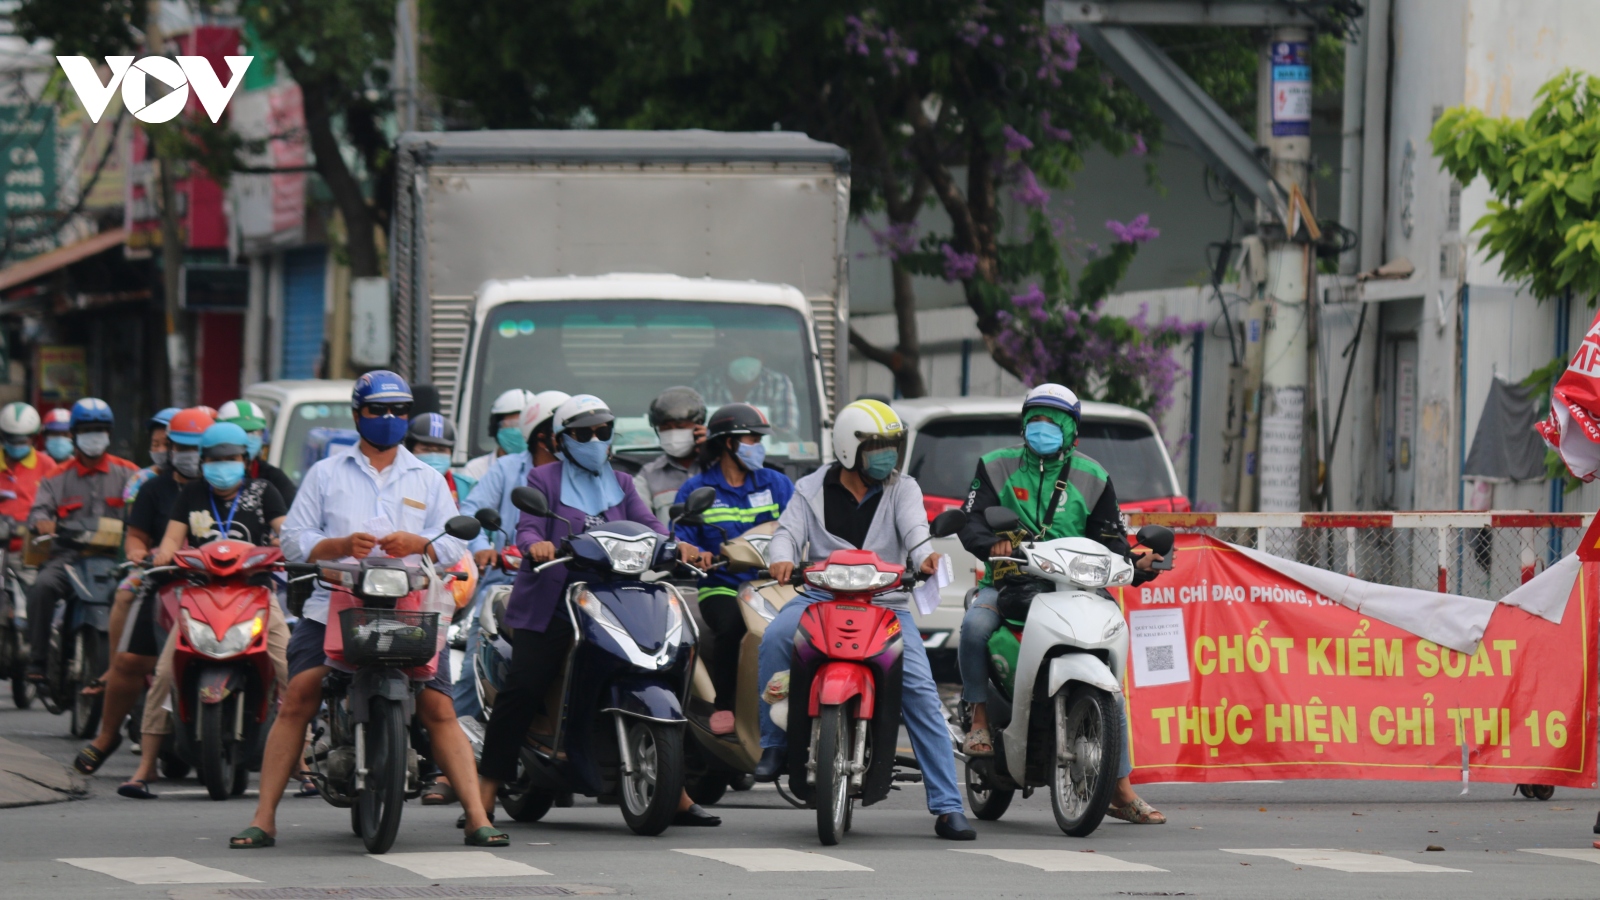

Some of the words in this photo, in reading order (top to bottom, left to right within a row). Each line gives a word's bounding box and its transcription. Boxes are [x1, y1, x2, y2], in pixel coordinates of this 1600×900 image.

[1140, 587, 1176, 605] BAN
[1179, 580, 1208, 604] CHỈ
[1212, 584, 1246, 606] ĐẠO
[1250, 584, 1312, 607] PHÒNG,
[1194, 620, 1294, 676] CHỐT
[1307, 619, 1404, 676] KIỂM
[1152, 697, 1253, 757] THỰC
[1265, 696, 1358, 754] HIỆN
[1369, 693, 1435, 746] CHỈ
[1447, 707, 1511, 758] THỊ
[1525, 710, 1568, 748] 16
